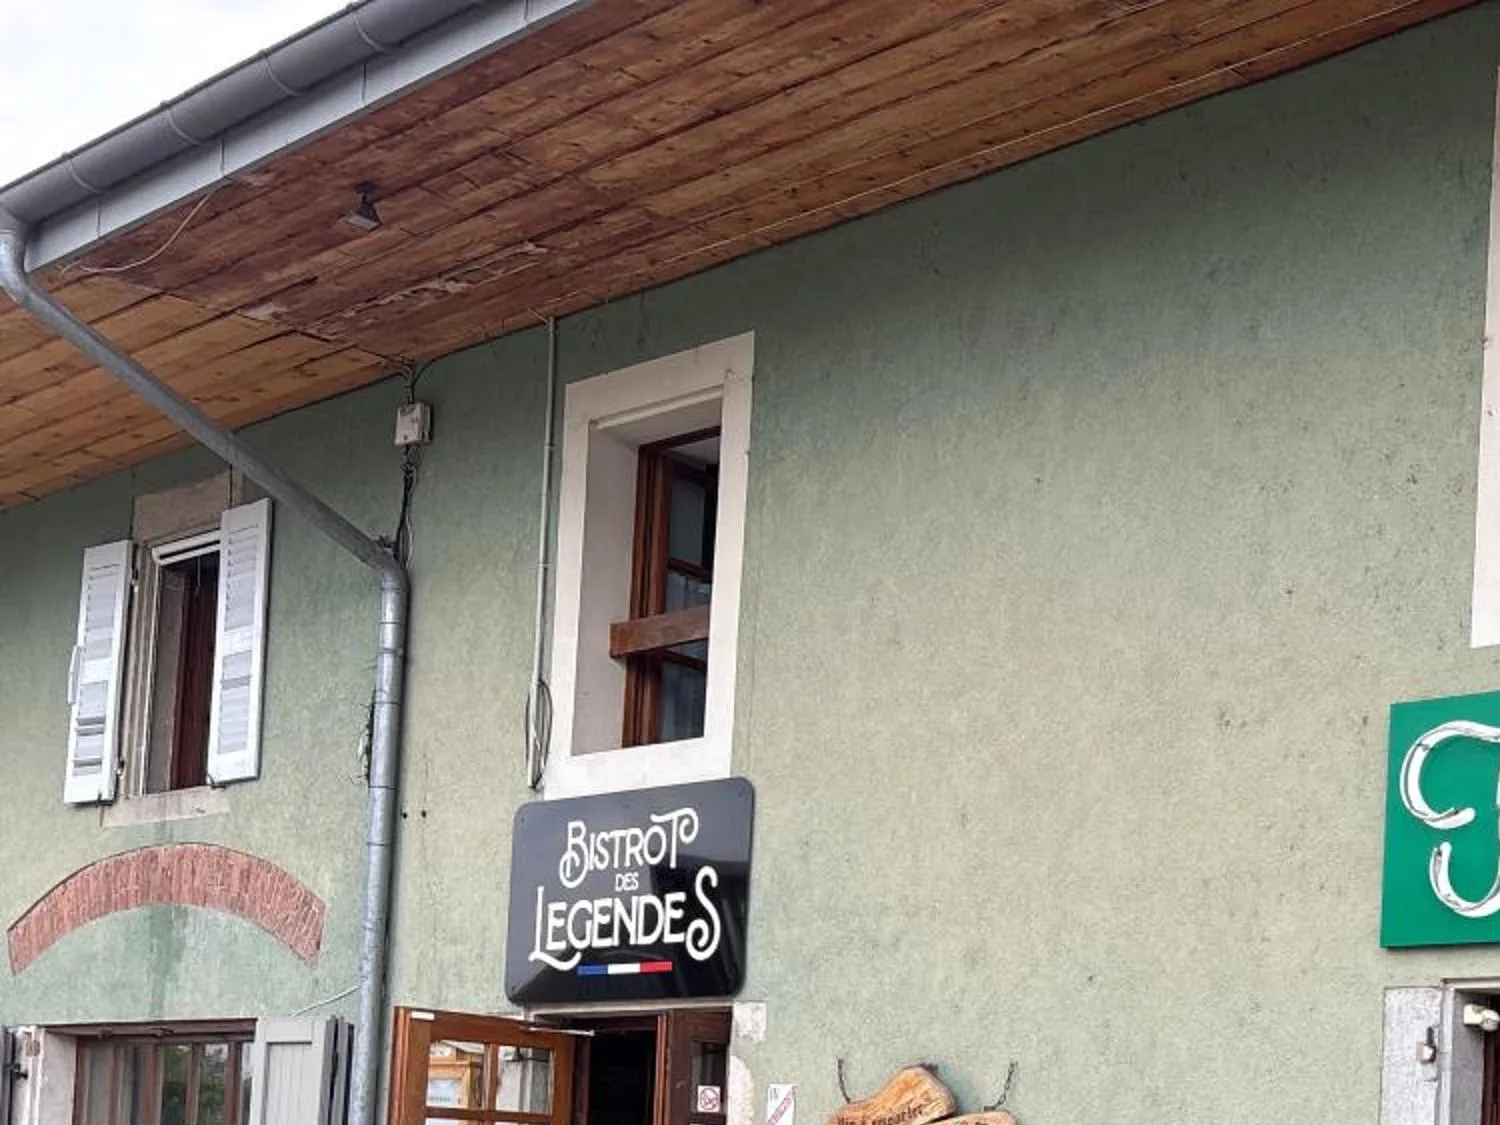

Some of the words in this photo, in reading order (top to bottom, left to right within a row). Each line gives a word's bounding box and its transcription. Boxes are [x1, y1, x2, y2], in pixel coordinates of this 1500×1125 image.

[559, 807, 699, 889] BISTROT
[614, 871, 640, 892] DES
[528, 865, 721, 971] LEGENDES
